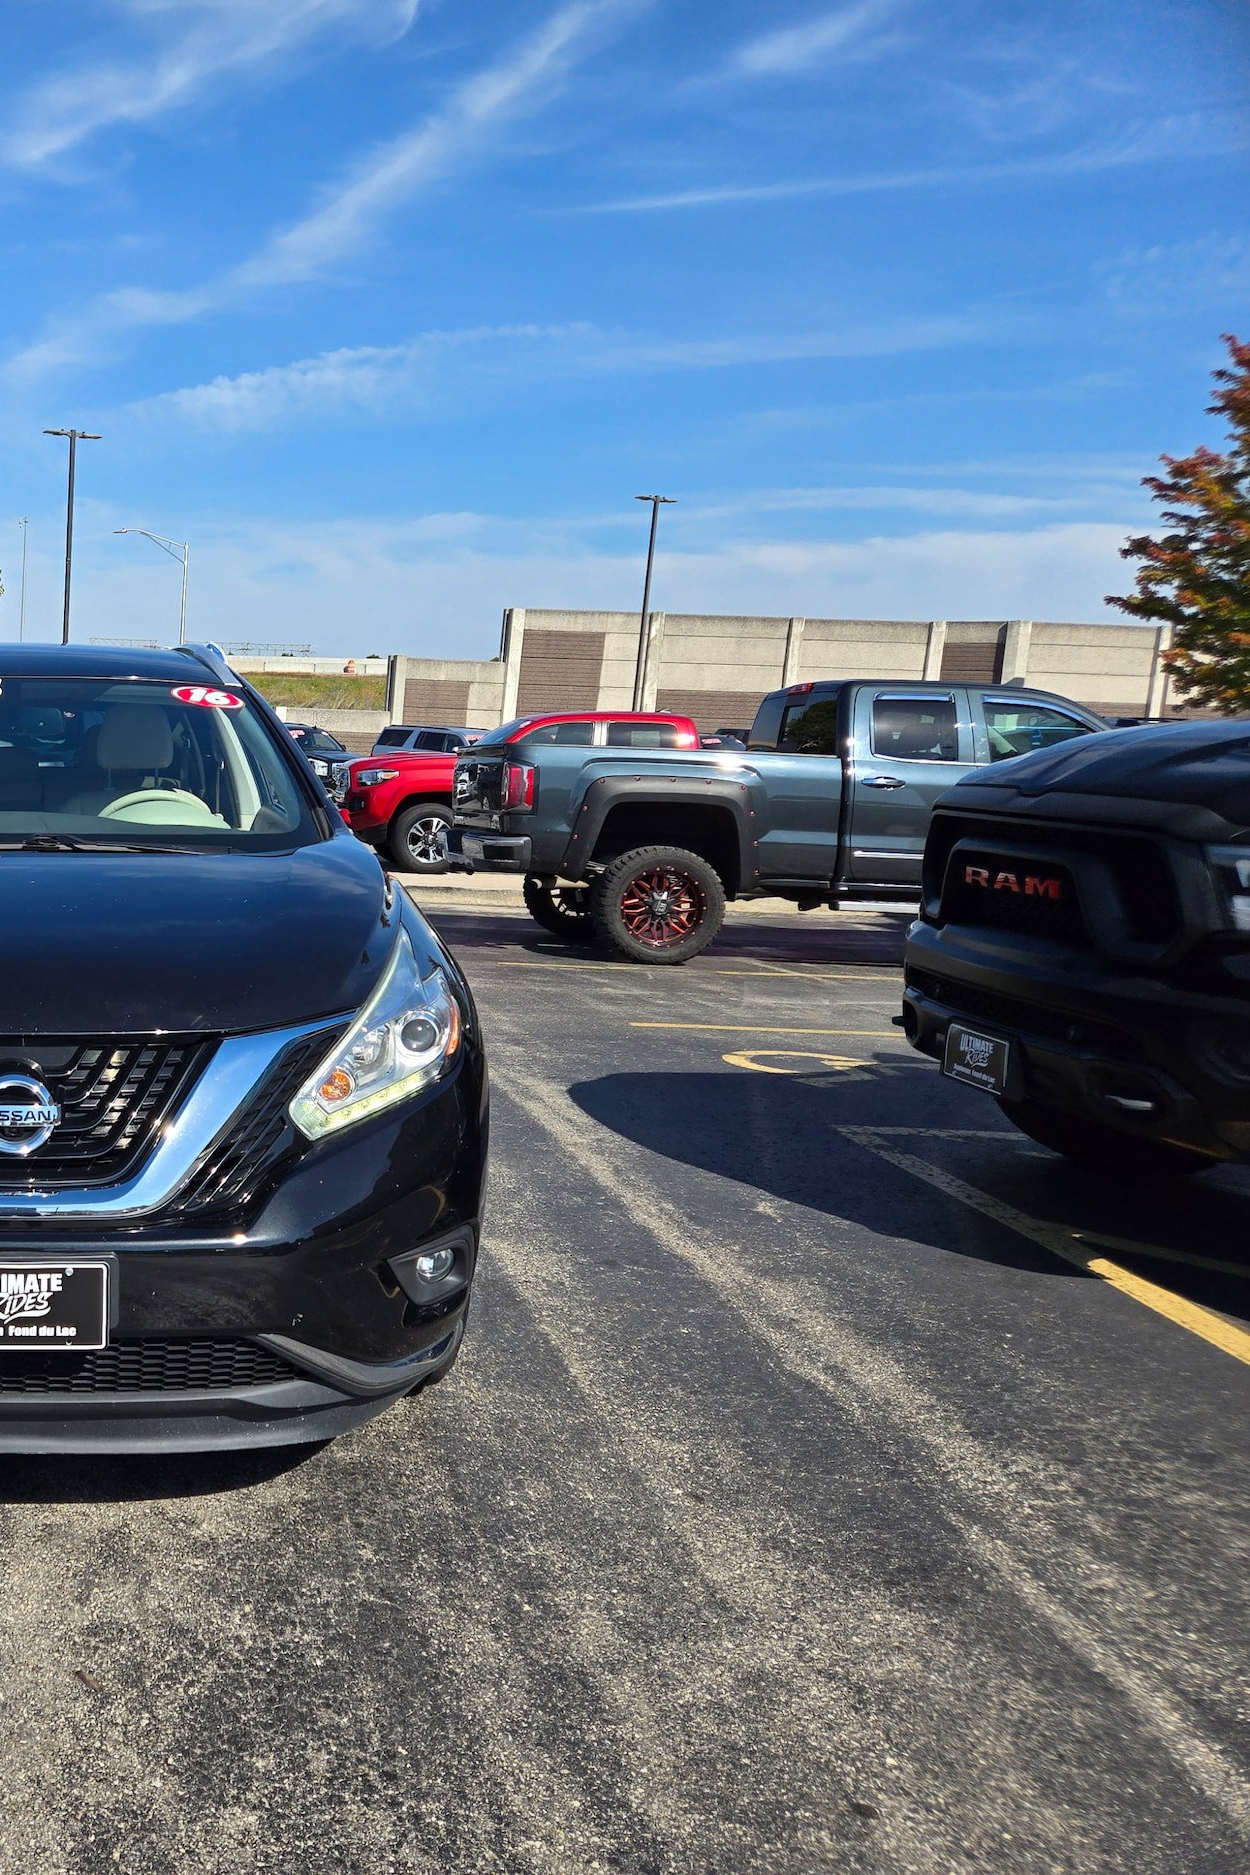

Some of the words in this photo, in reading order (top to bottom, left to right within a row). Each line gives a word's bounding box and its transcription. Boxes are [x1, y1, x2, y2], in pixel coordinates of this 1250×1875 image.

[189, 687, 231, 705] 16
[965, 866, 1059, 899] RAM
[959, 1033, 994, 1054] ULTIMATE
[8, 1325, 37, 1337] Fond
[38, 1325, 54, 1337] du
[56, 1325, 77, 1337] Lac
